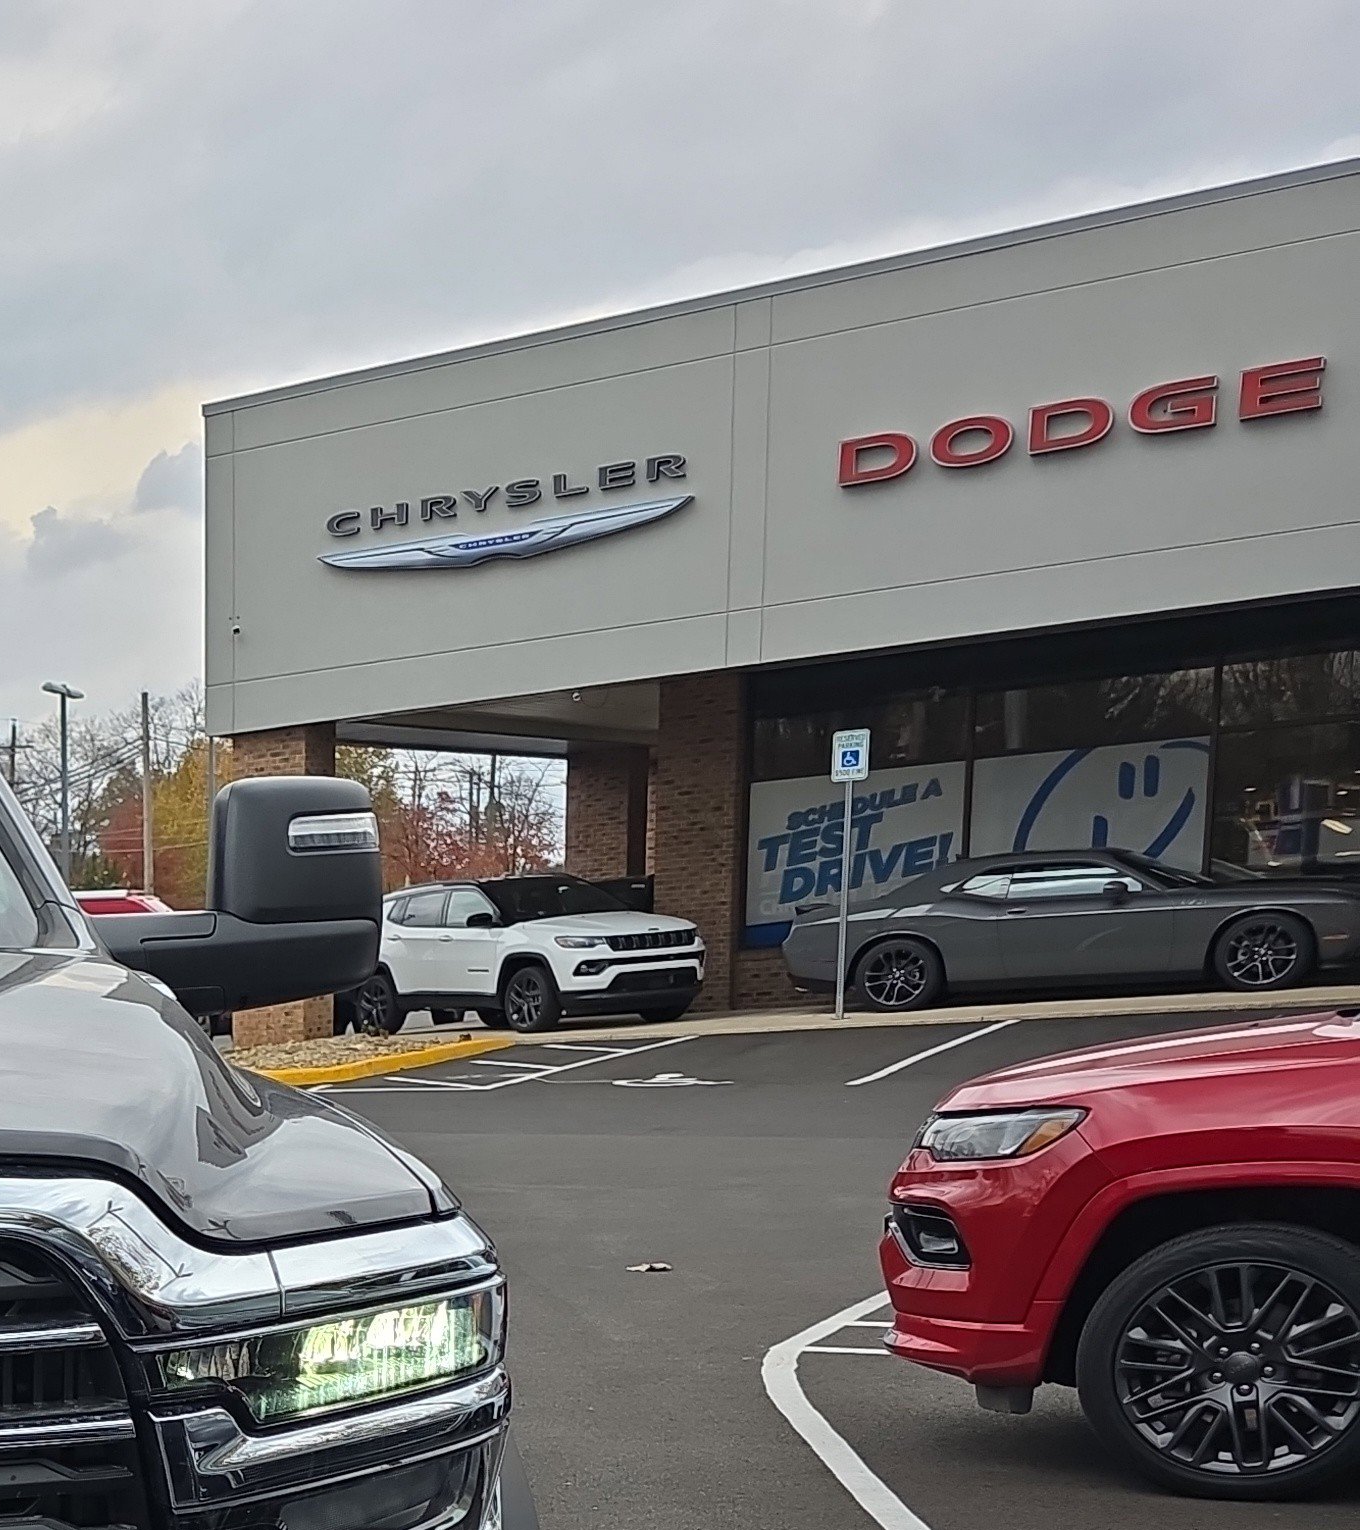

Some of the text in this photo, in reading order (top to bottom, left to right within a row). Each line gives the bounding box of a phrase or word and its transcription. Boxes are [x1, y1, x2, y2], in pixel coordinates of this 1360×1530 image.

[837, 356, 1326, 487] DODGE
[326, 453, 688, 536] CHRYSLER
[458, 534, 530, 549] CHRYSLER
[920, 778, 942, 800] A
[758, 812, 883, 872] TEST
[779, 832, 953, 904] DRIVE!
